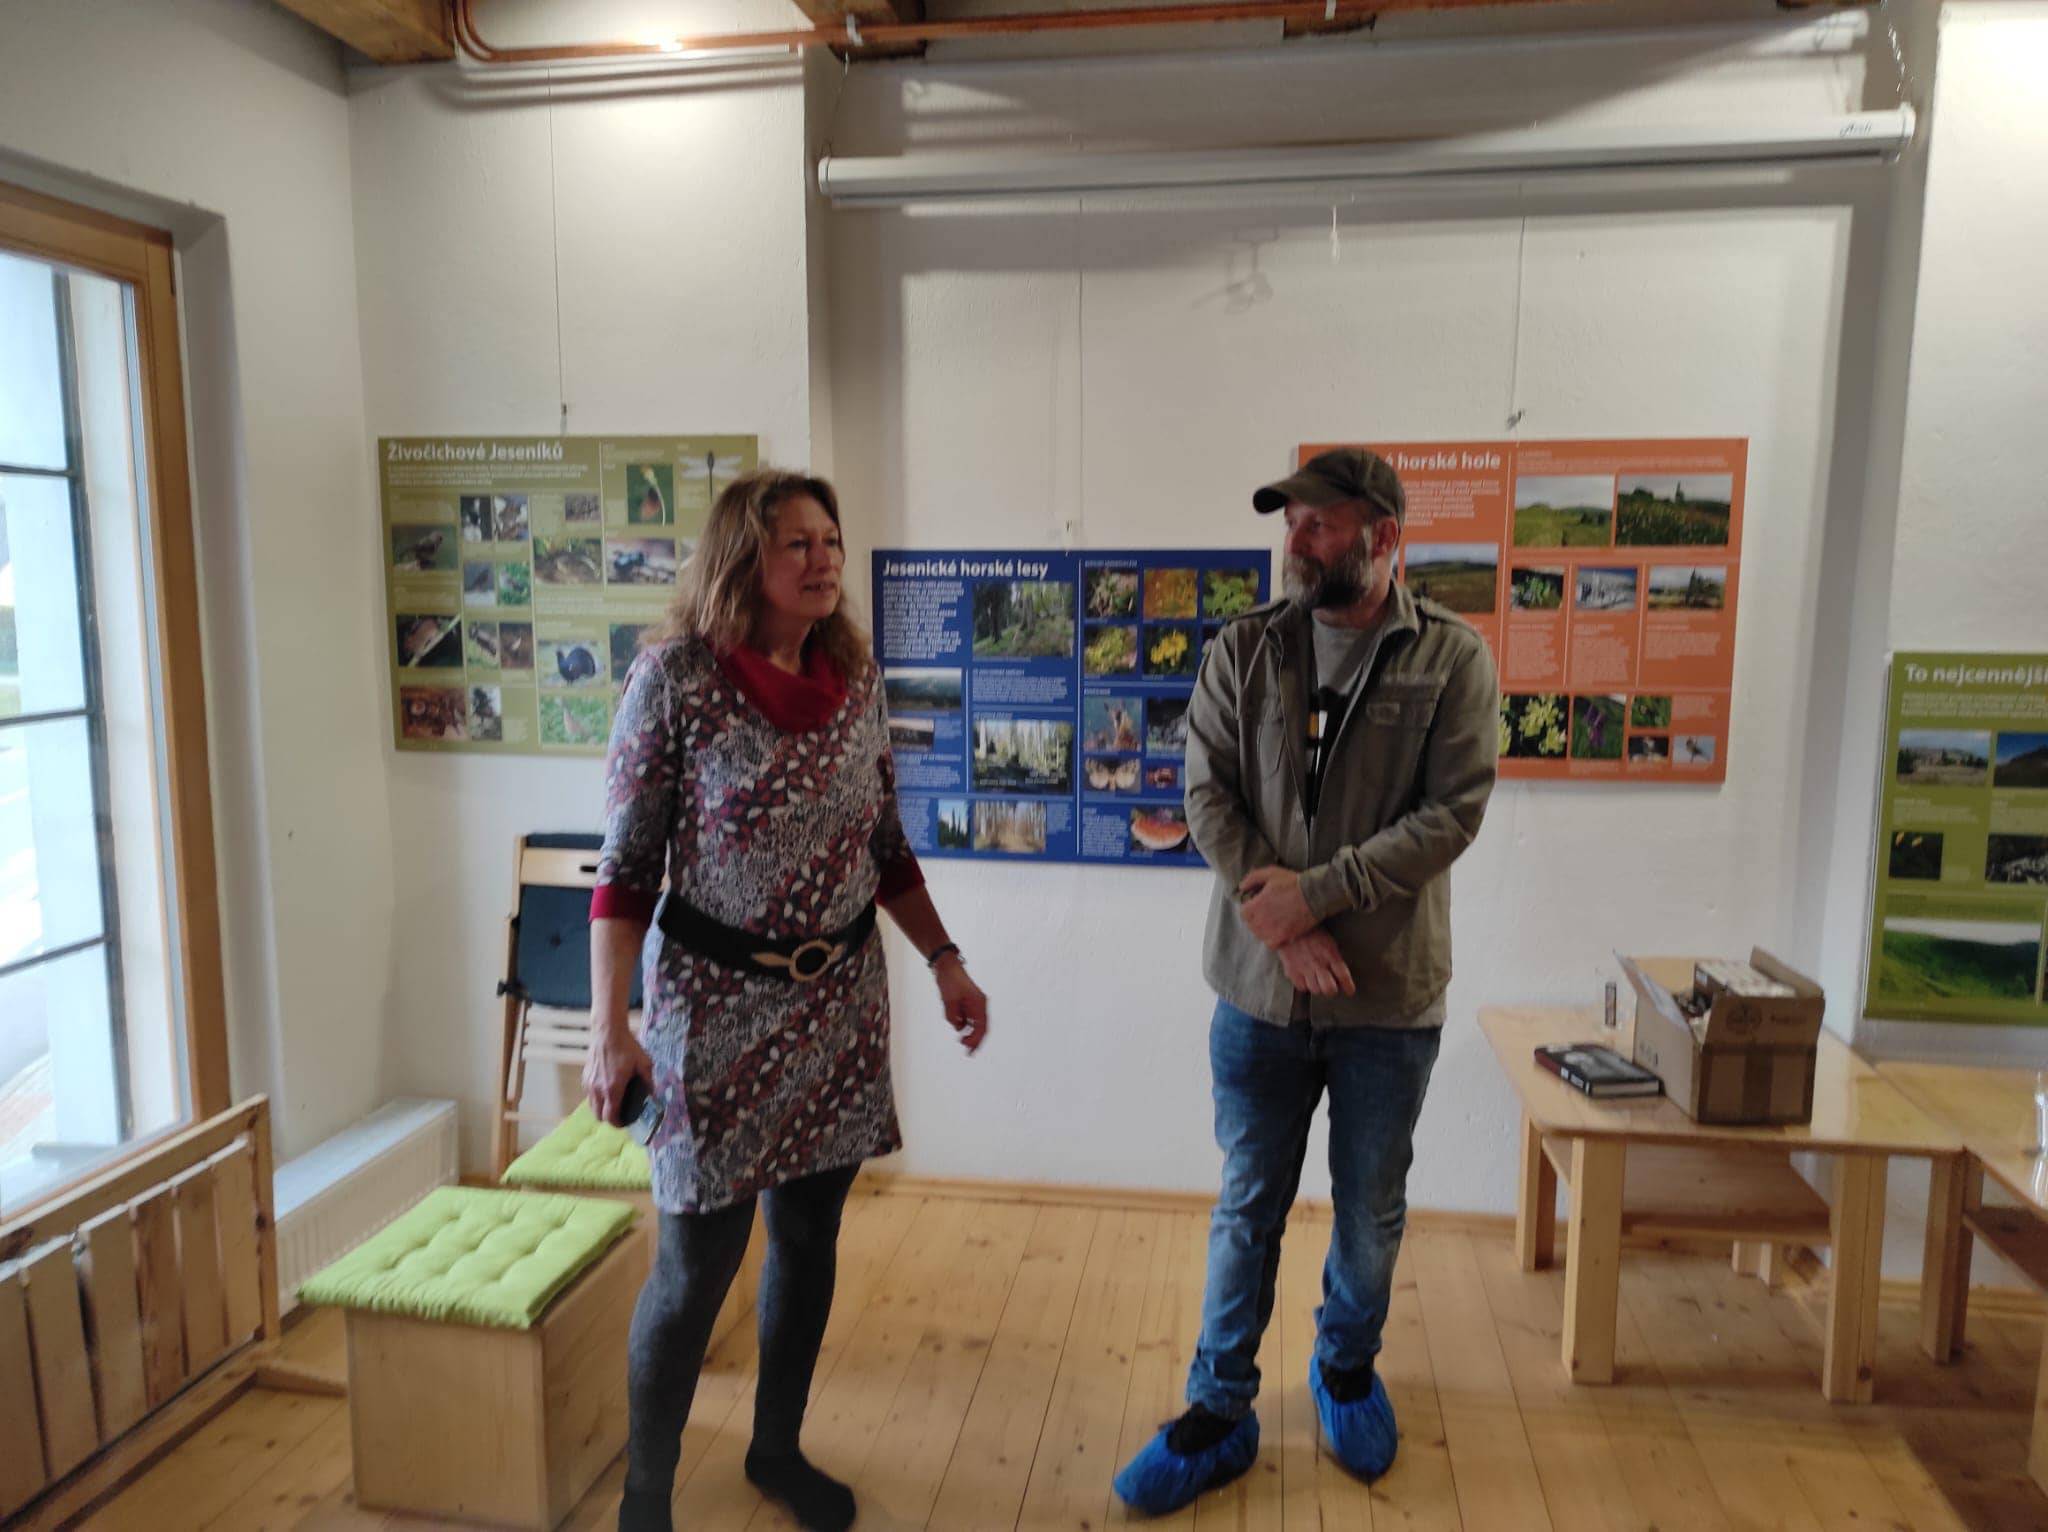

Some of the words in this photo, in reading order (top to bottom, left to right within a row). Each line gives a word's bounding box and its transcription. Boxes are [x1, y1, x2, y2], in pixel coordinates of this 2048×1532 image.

[388, 440, 486, 460] Živočichové
[488, 440, 564, 460] Jeseníků
[1397, 451, 1457, 470] horské
[1462, 450, 1501, 470] hole
[882, 558, 957, 577] Jesenické
[961, 558, 1013, 577] horské
[1017, 558, 1049, 581] lesy
[1904, 662, 1928, 683] To
